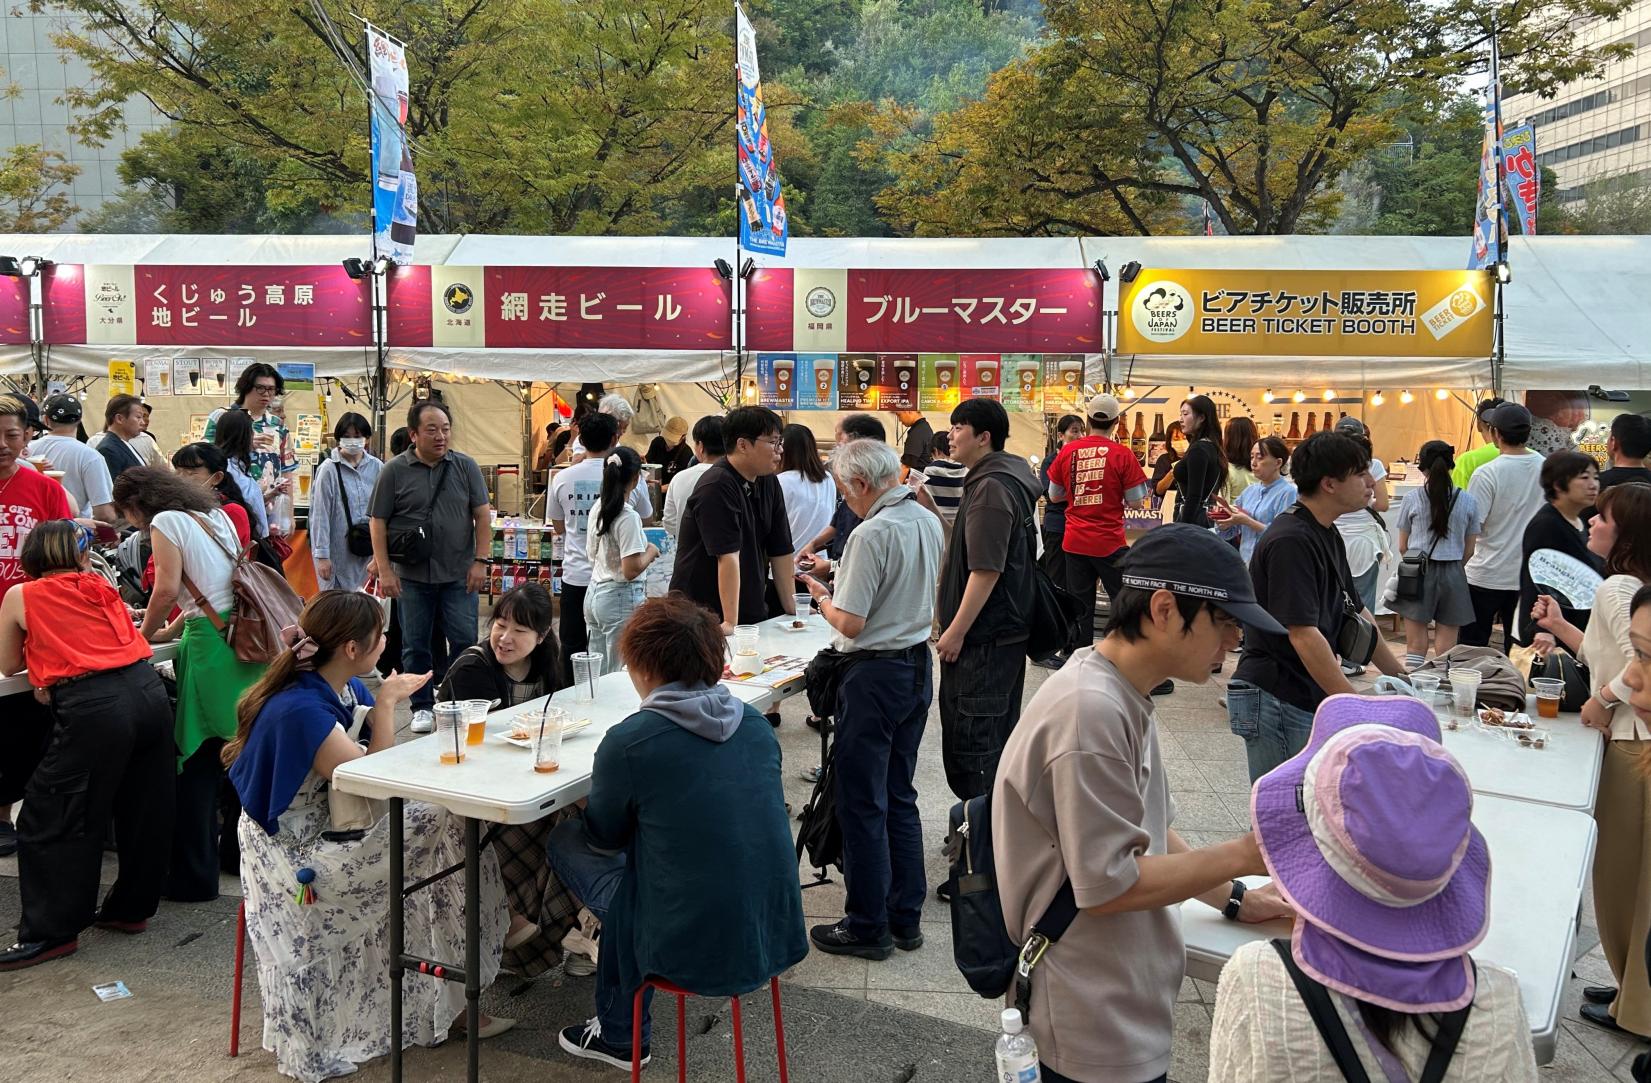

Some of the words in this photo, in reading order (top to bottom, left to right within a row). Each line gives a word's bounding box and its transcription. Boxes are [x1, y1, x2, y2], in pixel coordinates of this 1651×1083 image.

[153, 284, 315, 305] くじゅう高原
[500, 292, 683, 321] 網走ビール
[1202, 290, 1416, 316] ビアチケット販売所
[863, 295, 1068, 325] ブルーマスター
[152, 306, 257, 328] 地ビール
[1148, 318, 1177, 328] JAPAN
[1429, 308, 1449, 326] BEER
[807, 322, 833, 330] 福岡県
[1202, 318, 1256, 334] BEER
[1263, 319, 1336, 334] TICKET
[1343, 319, 1415, 334] BOOTH
[1216, 403, 1231, 419] HE
[1079, 447, 1096, 458] WE
[1580, 444, 1608, 452] BEERS
[1078, 458, 1105, 470] BEER!
[1077, 470, 1104, 483] SMILE
[1075, 485, 1085, 494] IS
[568, 493, 601, 501] PRIM
[1075, 494, 1102, 506] HERE!
[9, 505, 32, 516] GET
[1121, 510, 1162, 520] WMAST
[0, 512, 10, 524] K
[15, 514, 38, 528] ON
[1130, 578, 1149, 587] NORTH
[1150, 580, 1167, 589] FACE
[1173, 584, 1187, 592] THE
[1188, 586, 1212, 596] NORTH
[1214, 590, 1228, 598] FAC
